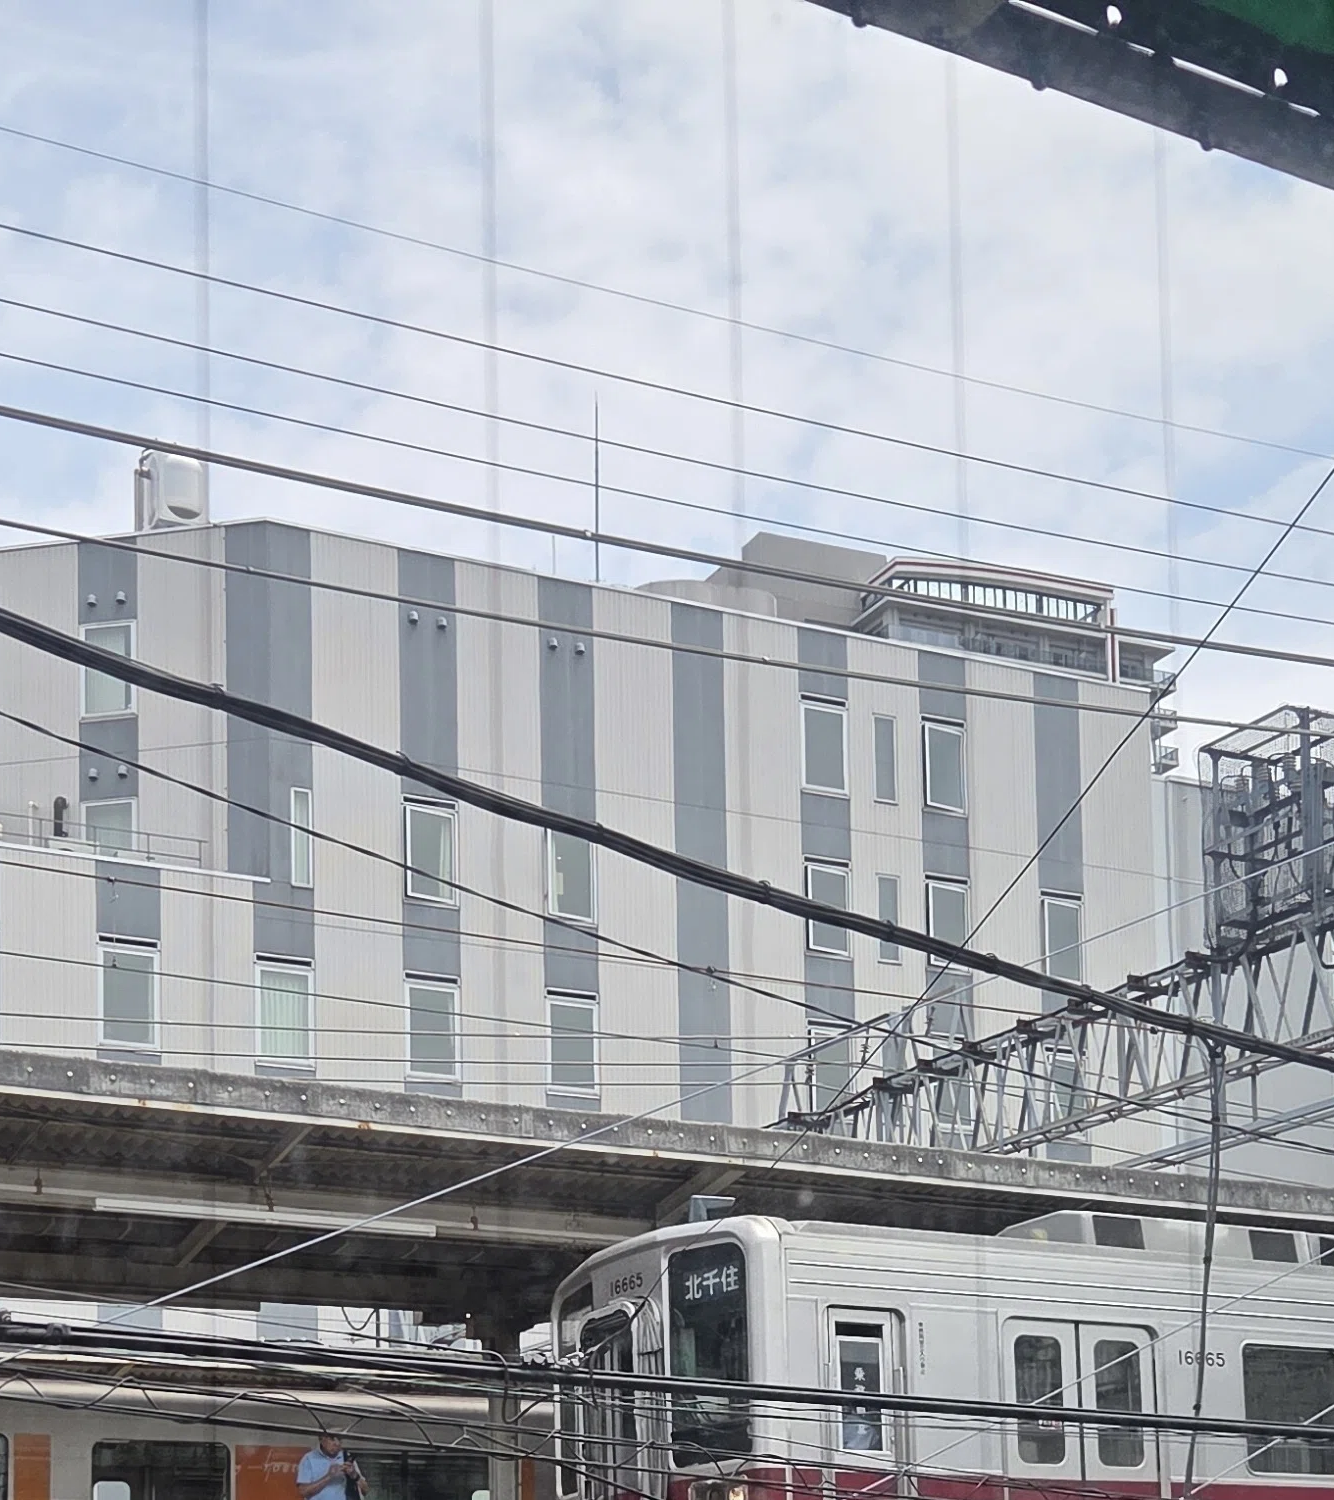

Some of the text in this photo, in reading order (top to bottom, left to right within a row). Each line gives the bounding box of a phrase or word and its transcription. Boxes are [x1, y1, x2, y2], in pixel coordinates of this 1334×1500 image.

[609, 1272, 643, 1297] 16665
[685, 1265, 739, 1300] 北千住
